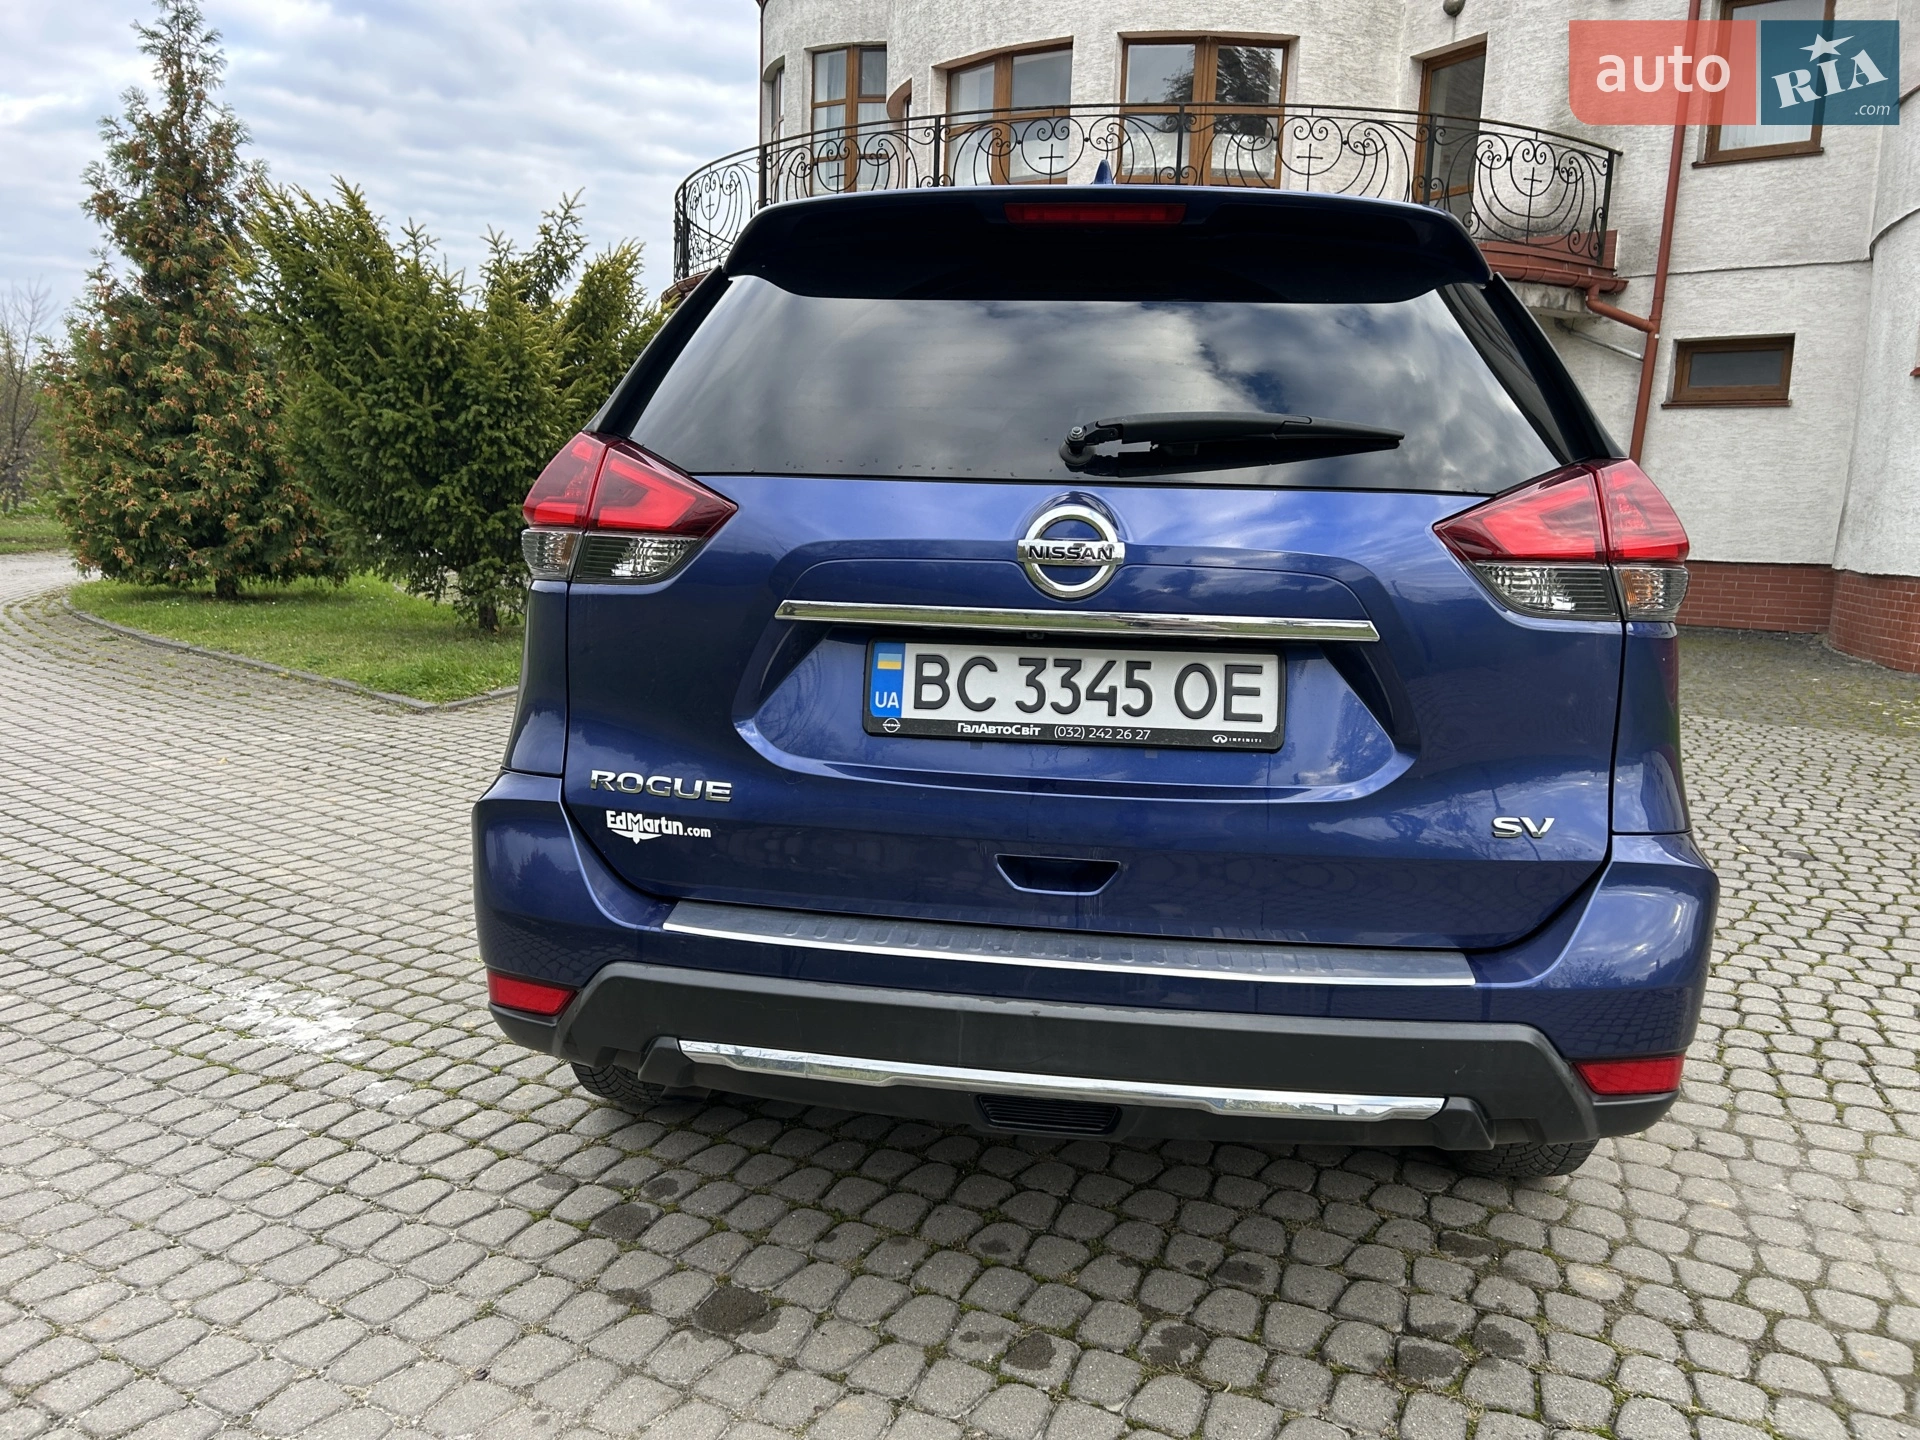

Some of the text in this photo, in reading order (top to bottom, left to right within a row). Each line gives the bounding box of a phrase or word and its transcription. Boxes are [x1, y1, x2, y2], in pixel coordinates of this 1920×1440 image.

[1028, 545, 1114, 560] NISSAN
[913, 653, 1264, 723] BC 3345 OE
[875, 690, 900, 709] UA
[957, 722, 1042, 736] ГалАвтоСвіт
[1054, 725, 1151, 741] (032) 242 26 27
[590, 769, 733, 802] ROGUE
[1492, 816, 1556, 838] SV
